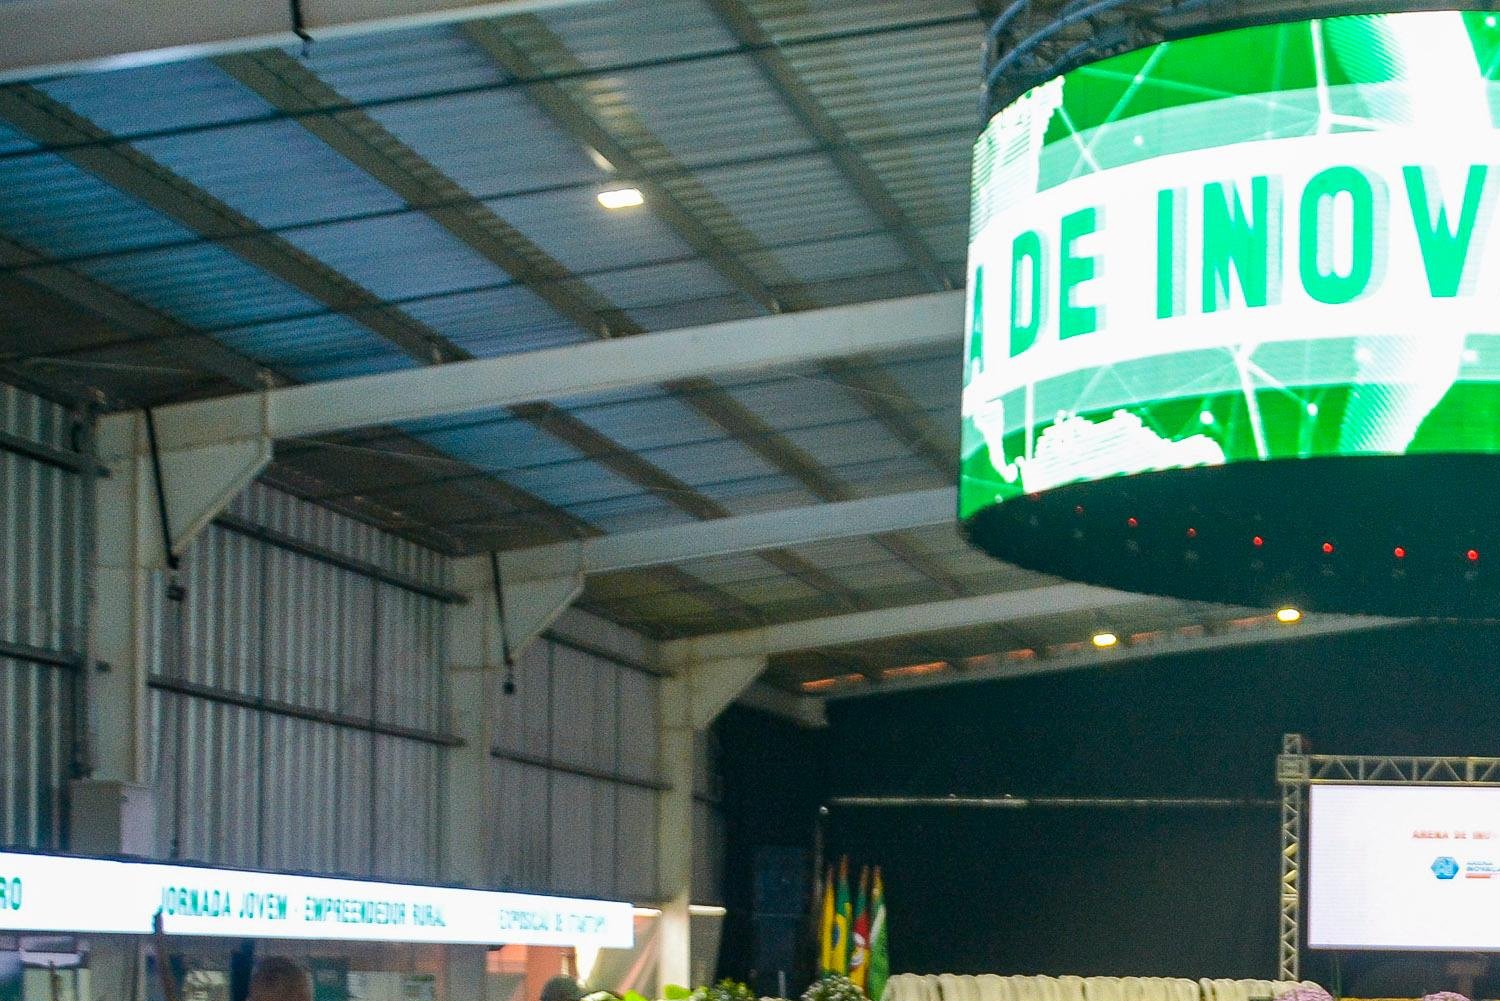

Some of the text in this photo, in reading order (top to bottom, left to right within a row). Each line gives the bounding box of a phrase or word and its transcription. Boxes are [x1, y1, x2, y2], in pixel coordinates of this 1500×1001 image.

[1009, 207, 1100, 358] DE
[162, 886, 232, 918] JORNADA
[239, 891, 288, 920] JOVEM
